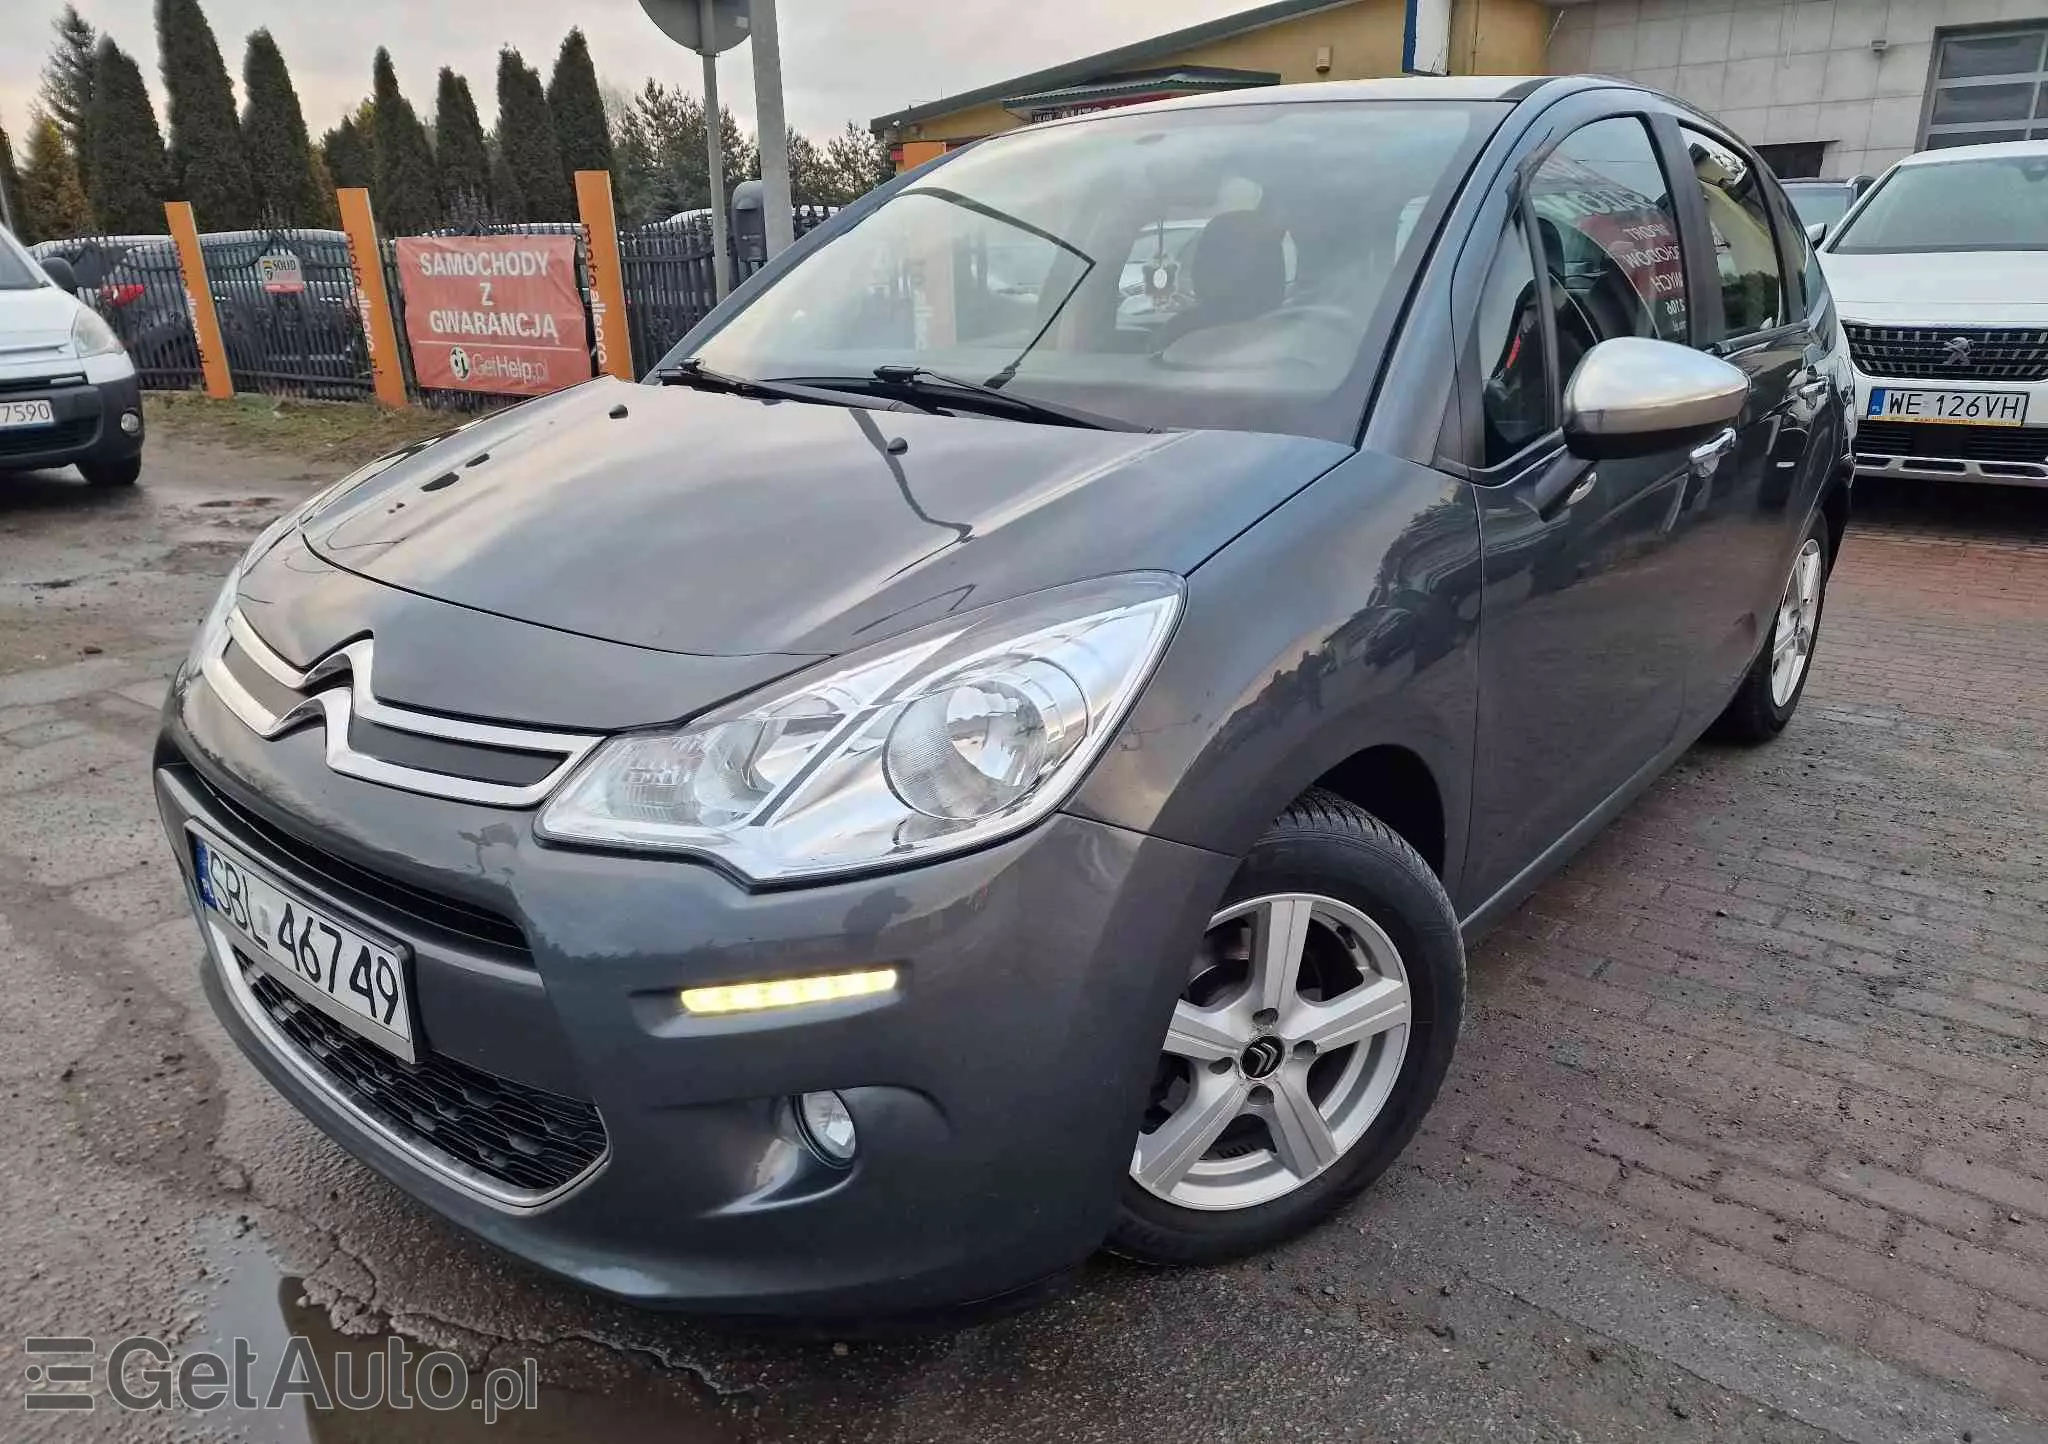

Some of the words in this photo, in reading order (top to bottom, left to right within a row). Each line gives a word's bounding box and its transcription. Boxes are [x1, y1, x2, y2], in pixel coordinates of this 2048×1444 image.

[419, 252, 549, 277] SAMOCHODY
[479, 282, 494, 306] Z
[429, 310, 560, 345] GWARANCJĄ
[471, 353, 548, 385] GetHelp.pl
[0, 403, 50, 422] 7590
[1889, 392, 1923, 415] WE
[1936, 394, 2020, 419] 126VH
[210, 850, 269, 951] SBL
[277, 902, 399, 1025] 46749
